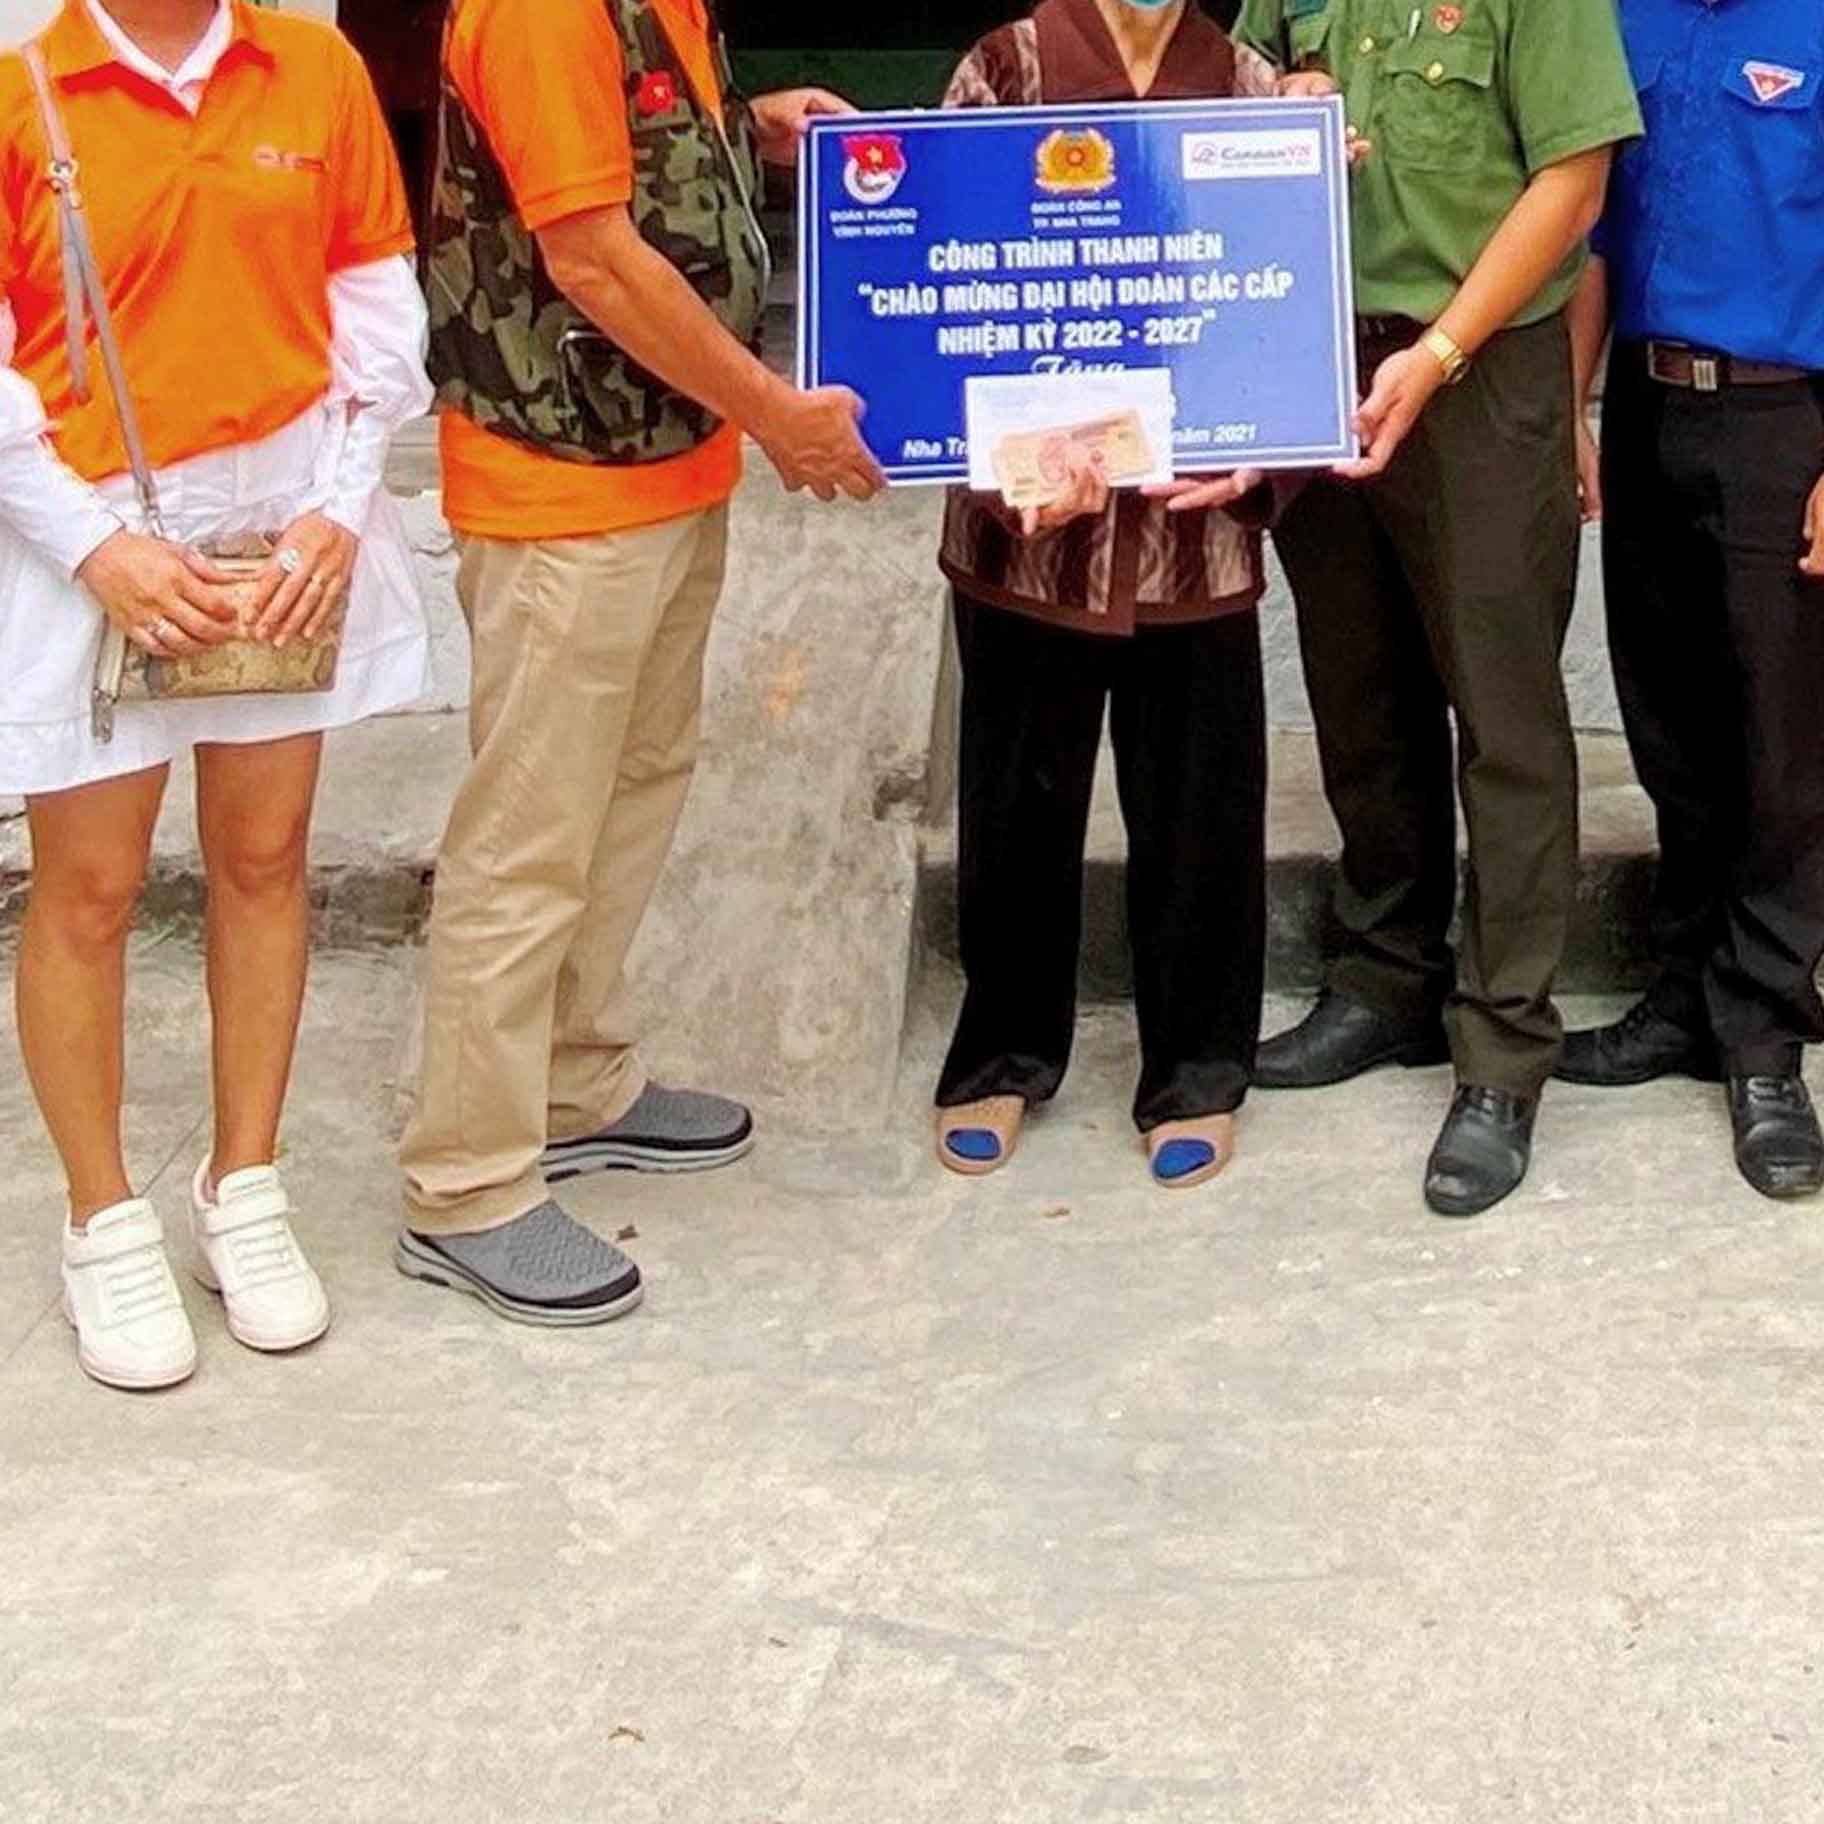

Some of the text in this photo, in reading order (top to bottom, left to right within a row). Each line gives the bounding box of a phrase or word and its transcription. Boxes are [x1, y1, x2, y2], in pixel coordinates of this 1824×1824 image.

[928, 229, 1225, 272] CÔNG TRÌNH THANH NIÊN
[943, 279, 1018, 312] MỪNG
[1023, 281, 1066, 314] ĐẠI
[1071, 272, 1113, 312] HỘI
[1118, 272, 1184, 306] ĐOÀN
[1190, 268, 1239, 302] CÁC
[1245, 261, 1294, 300] CẤP
[938, 320, 1020, 358] NHIỆM
[1025, 317, 1057, 352] KỲ
[1062, 319, 1123, 349] 2022
[1213, 423, 1257, 443] 2021
